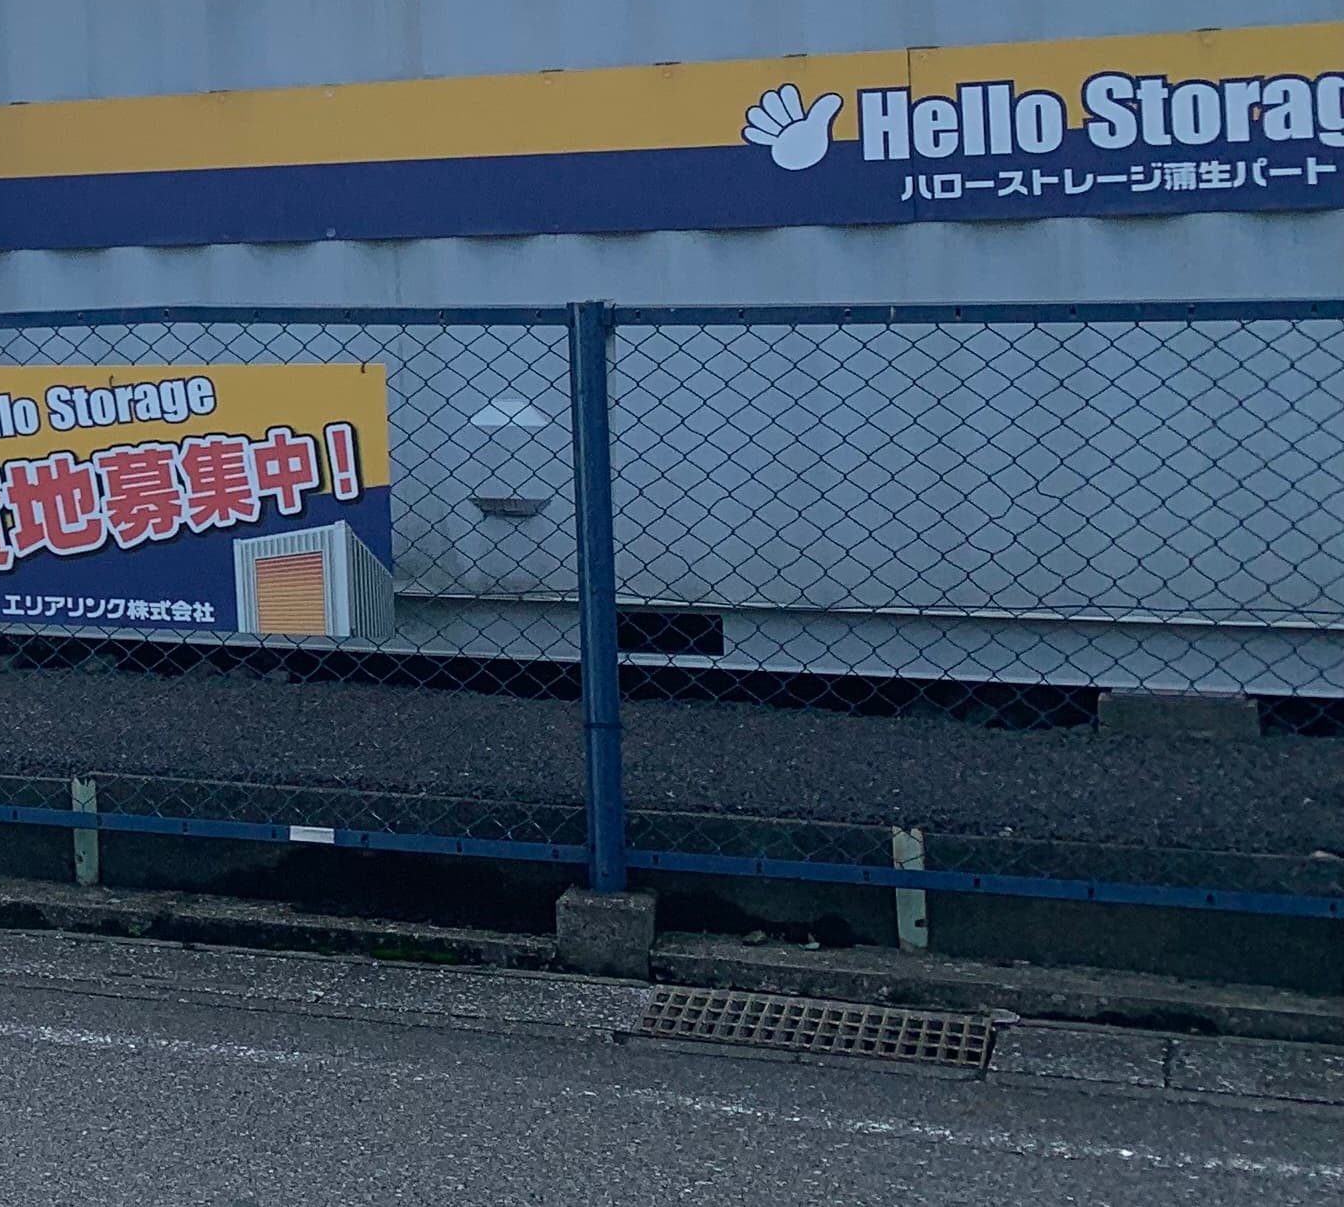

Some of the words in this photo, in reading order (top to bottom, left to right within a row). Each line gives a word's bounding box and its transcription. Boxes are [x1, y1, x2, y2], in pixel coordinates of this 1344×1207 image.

[859, 80, 1067, 161] Hello
[900, 156, 1338, 202] ハローストレージ蒲生パート
[45, 375, 216, 433] Storage
[2, 594, 214, 623] エリアリング株式会社
